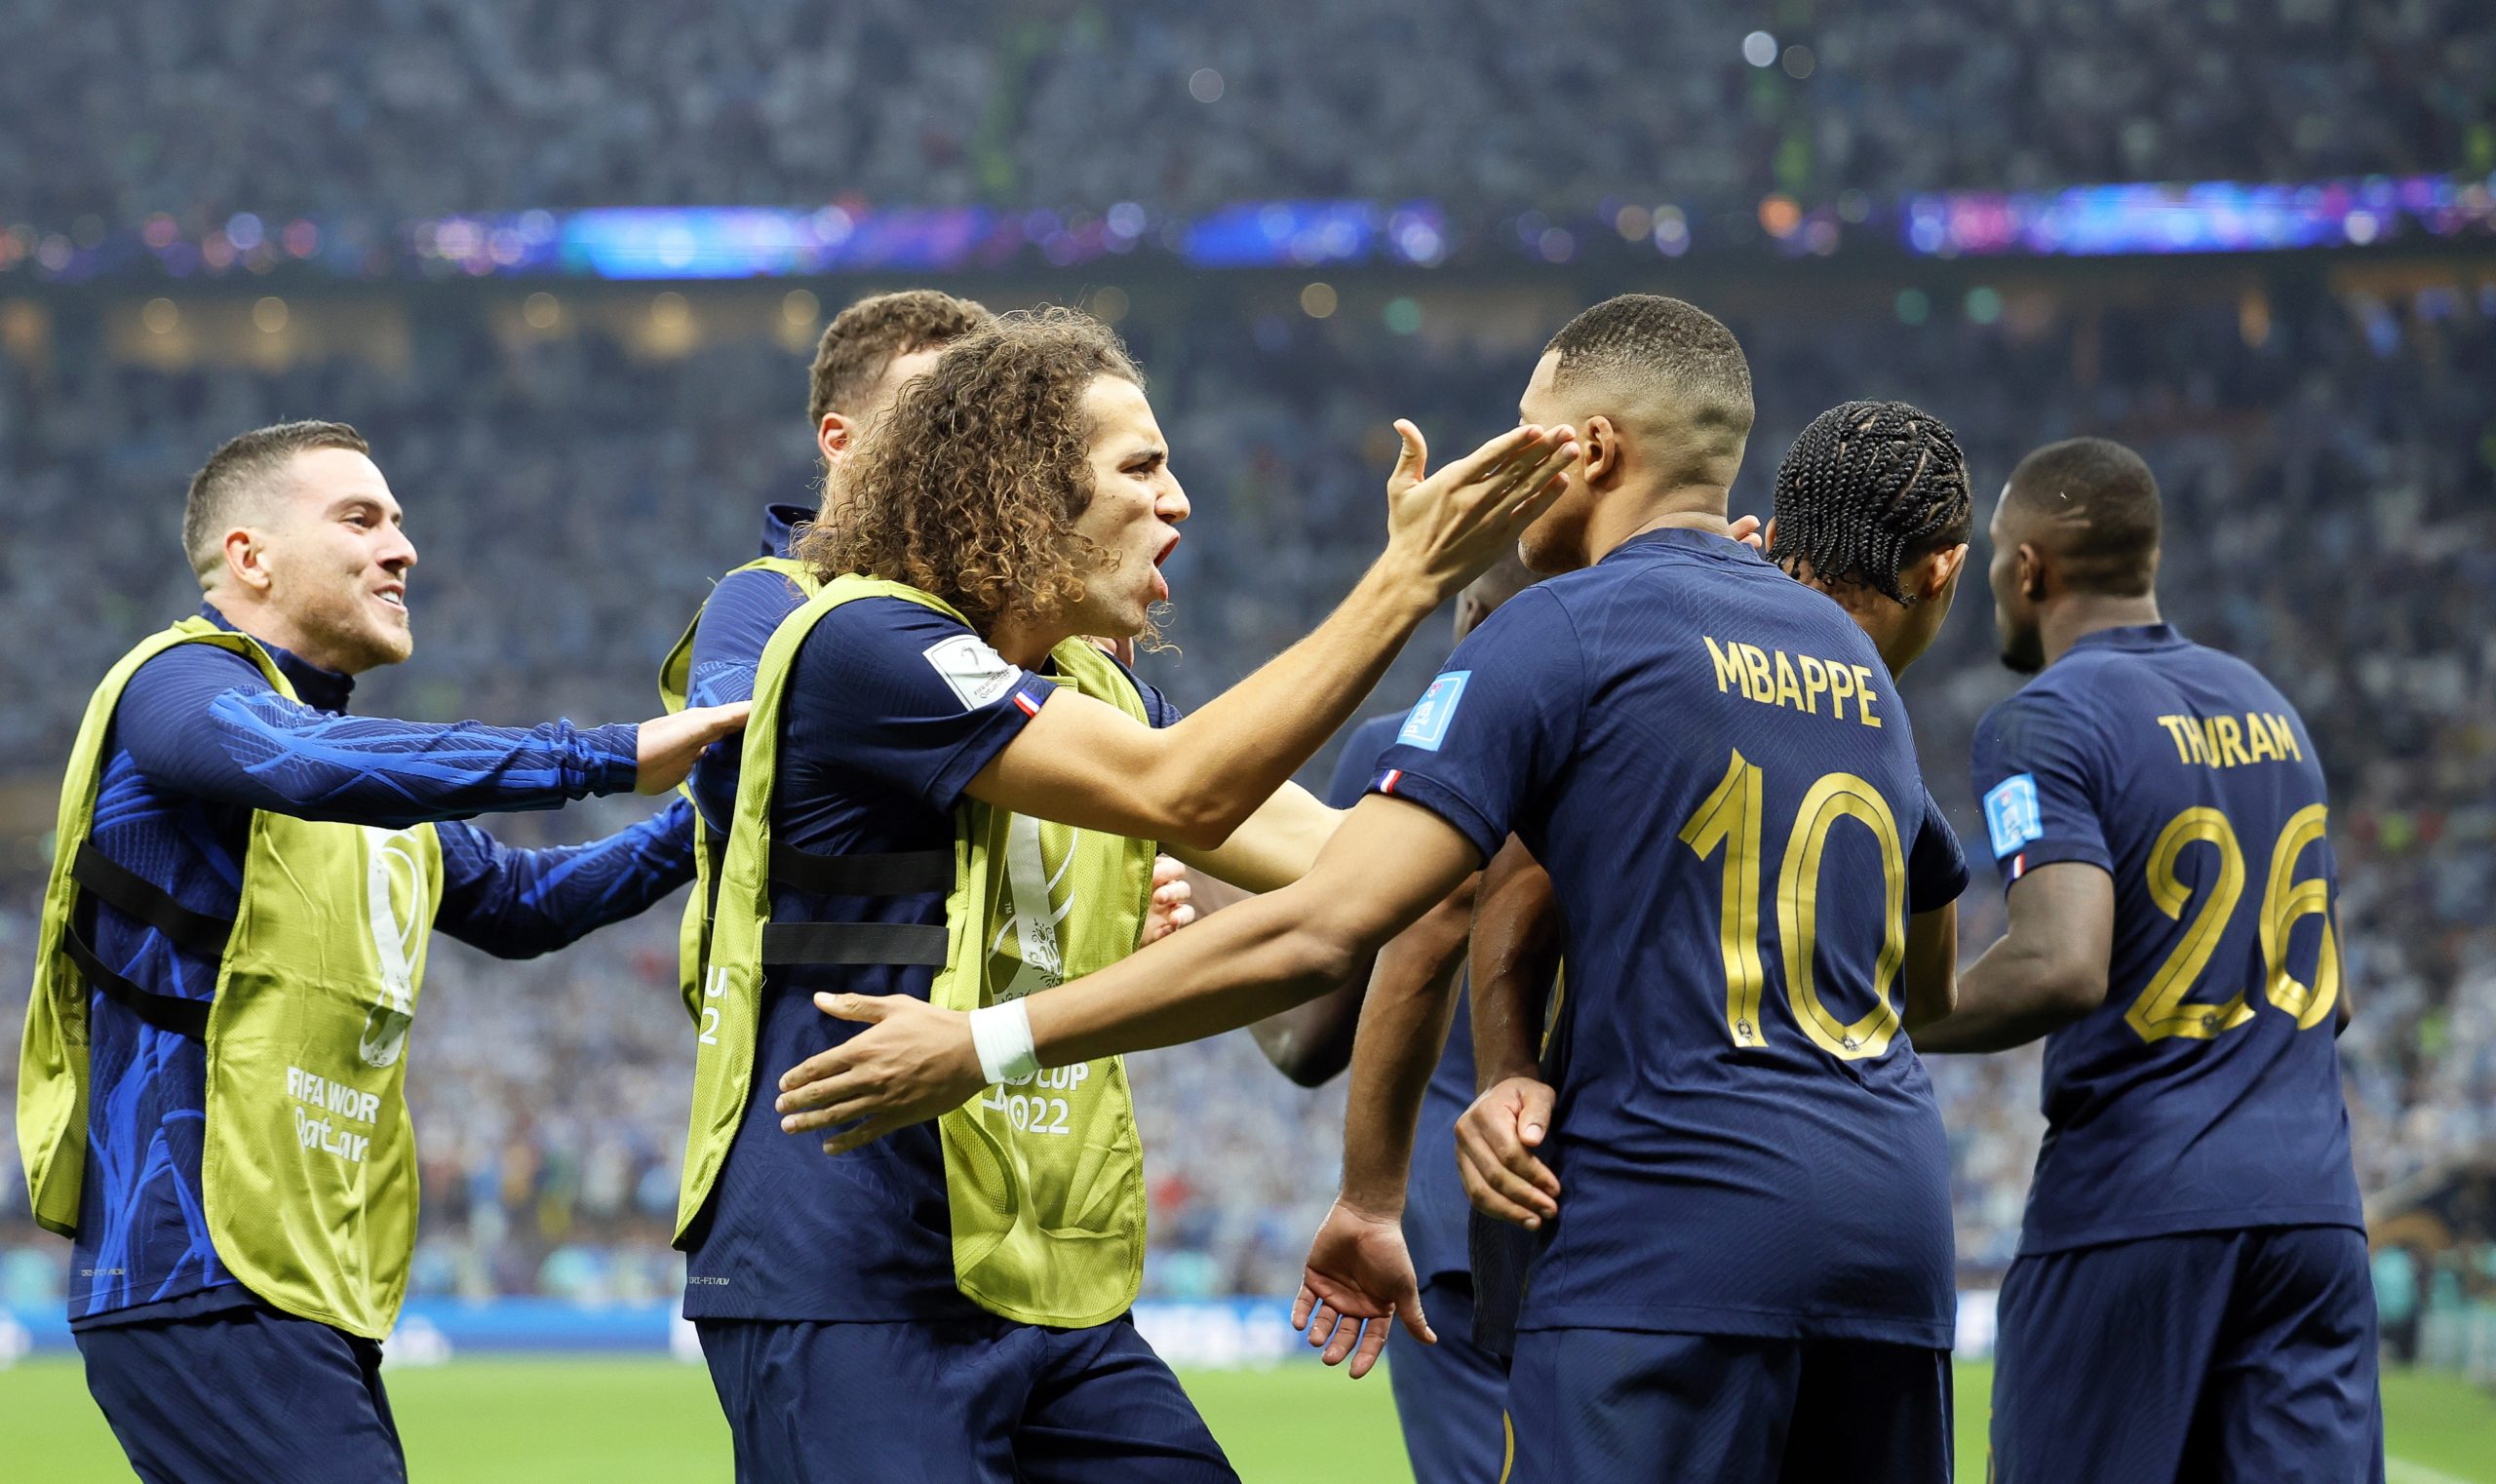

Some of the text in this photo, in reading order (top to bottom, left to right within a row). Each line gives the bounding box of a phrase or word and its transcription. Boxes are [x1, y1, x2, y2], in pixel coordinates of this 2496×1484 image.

[1702, 636, 1882, 728] MBAPPE
[2157, 712, 2303, 768] THURAM
[1678, 747, 1905, 1061] 10
[2124, 801, 2339, 1044] 26
[287, 1065, 381, 1125] FIFA WOR
[1035, 1061, 1090, 1092] CUP
[294, 1105, 370, 1163] Qatar
[1009, 1093, 1071, 1135] 022
